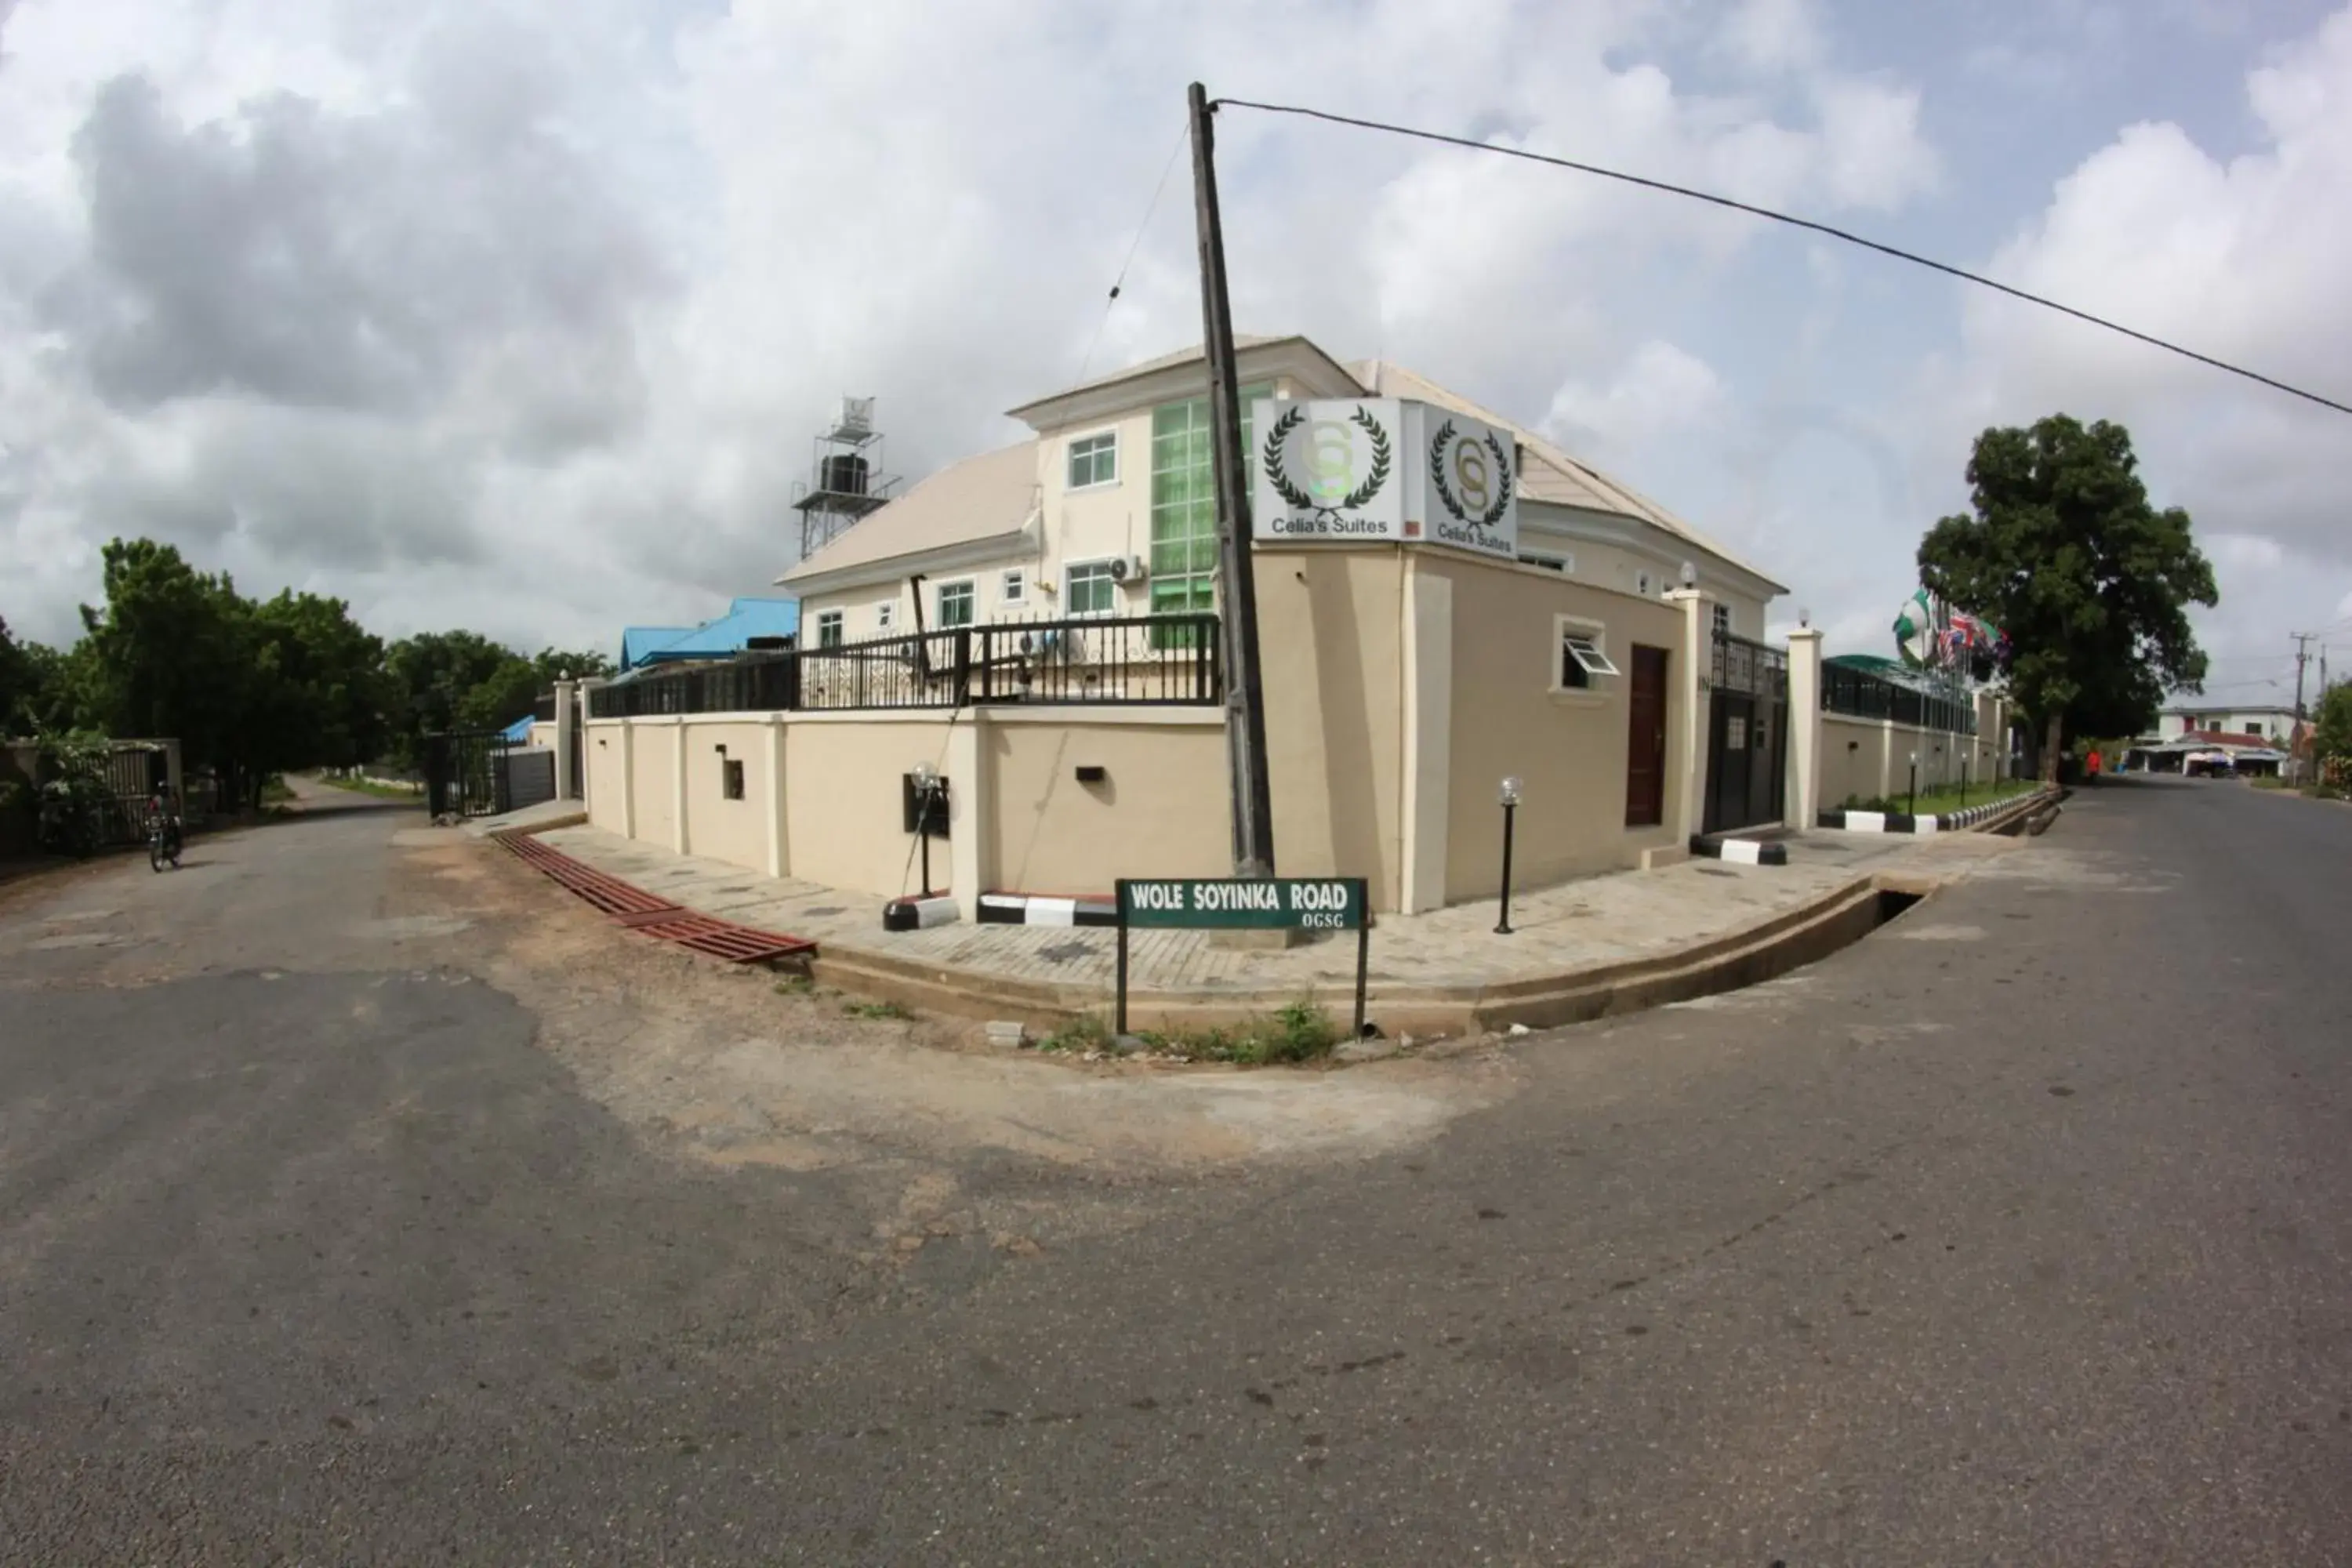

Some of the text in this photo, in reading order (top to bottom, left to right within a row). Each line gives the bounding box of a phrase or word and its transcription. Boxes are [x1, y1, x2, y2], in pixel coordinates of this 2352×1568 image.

[1272, 517, 1388, 533] Celia's Suites
[1131, 883, 1348, 909] WOLE SOYINKA ROAD
[1302, 913, 1343, 927] OGSG
